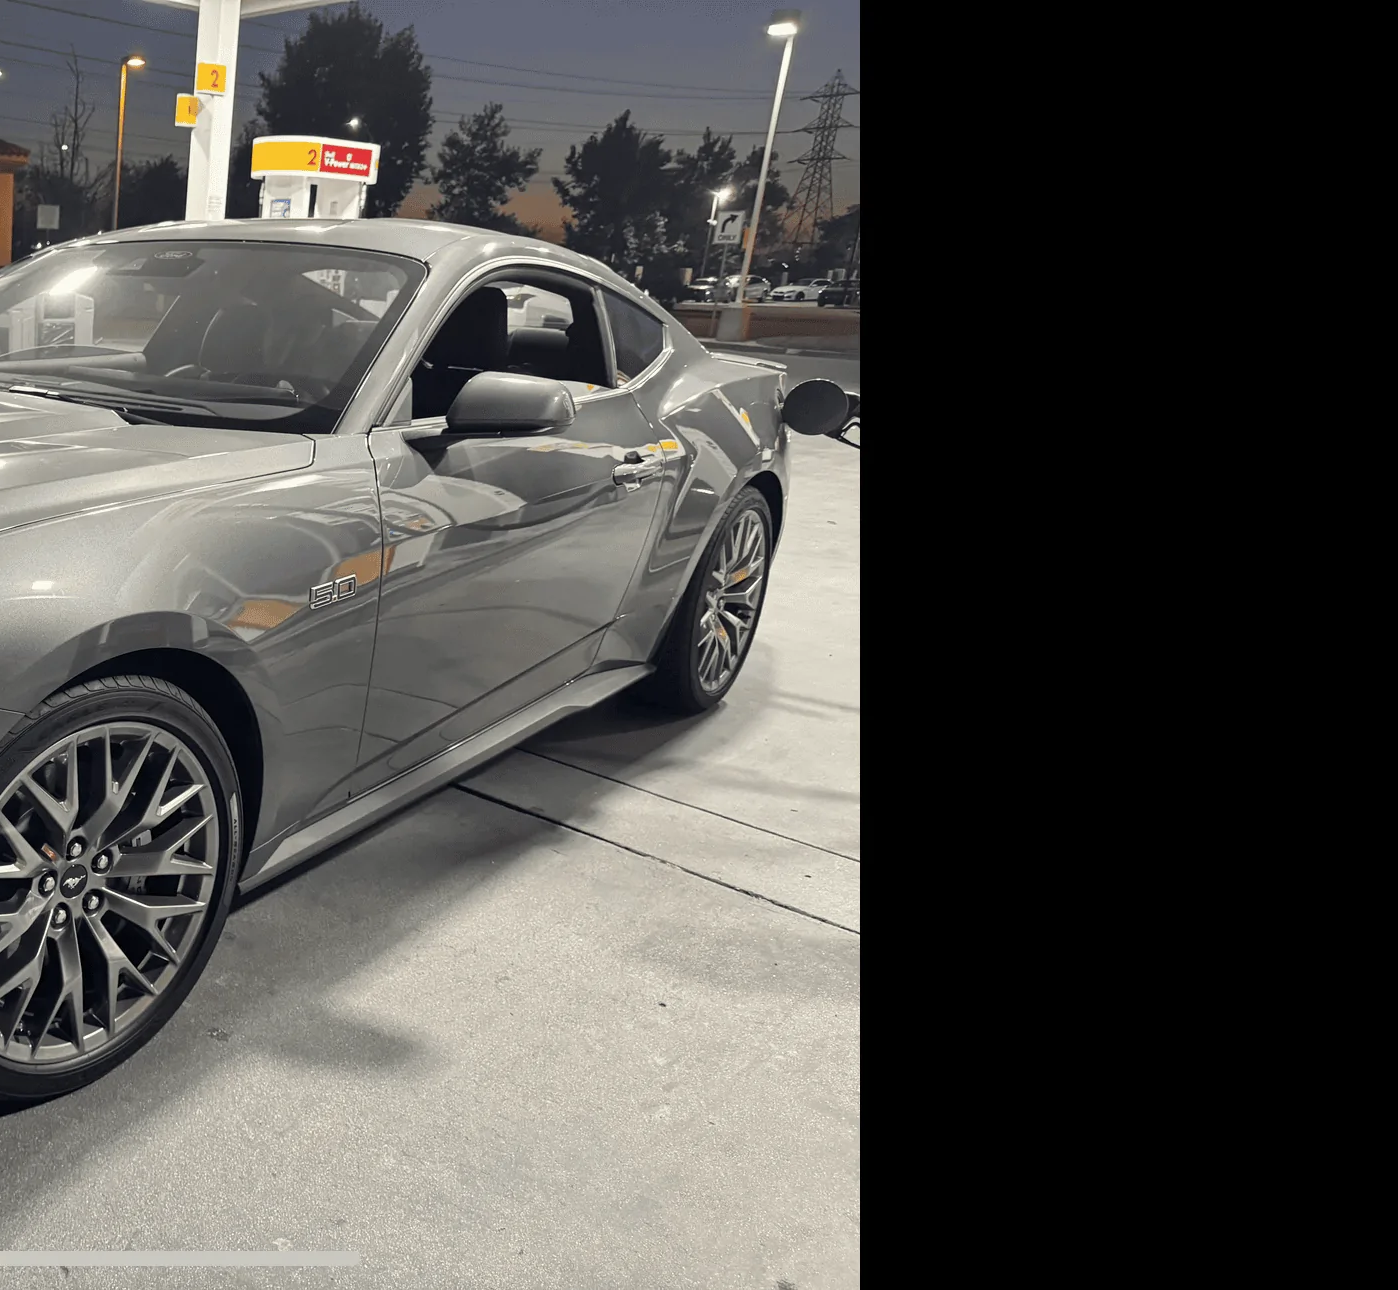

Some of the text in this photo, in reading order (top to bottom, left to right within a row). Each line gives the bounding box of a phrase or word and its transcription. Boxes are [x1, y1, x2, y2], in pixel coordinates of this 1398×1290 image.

[210, 69, 219, 88] 2
[307, 149, 317, 166] 2
[309, 574, 357, 610] 5.0
